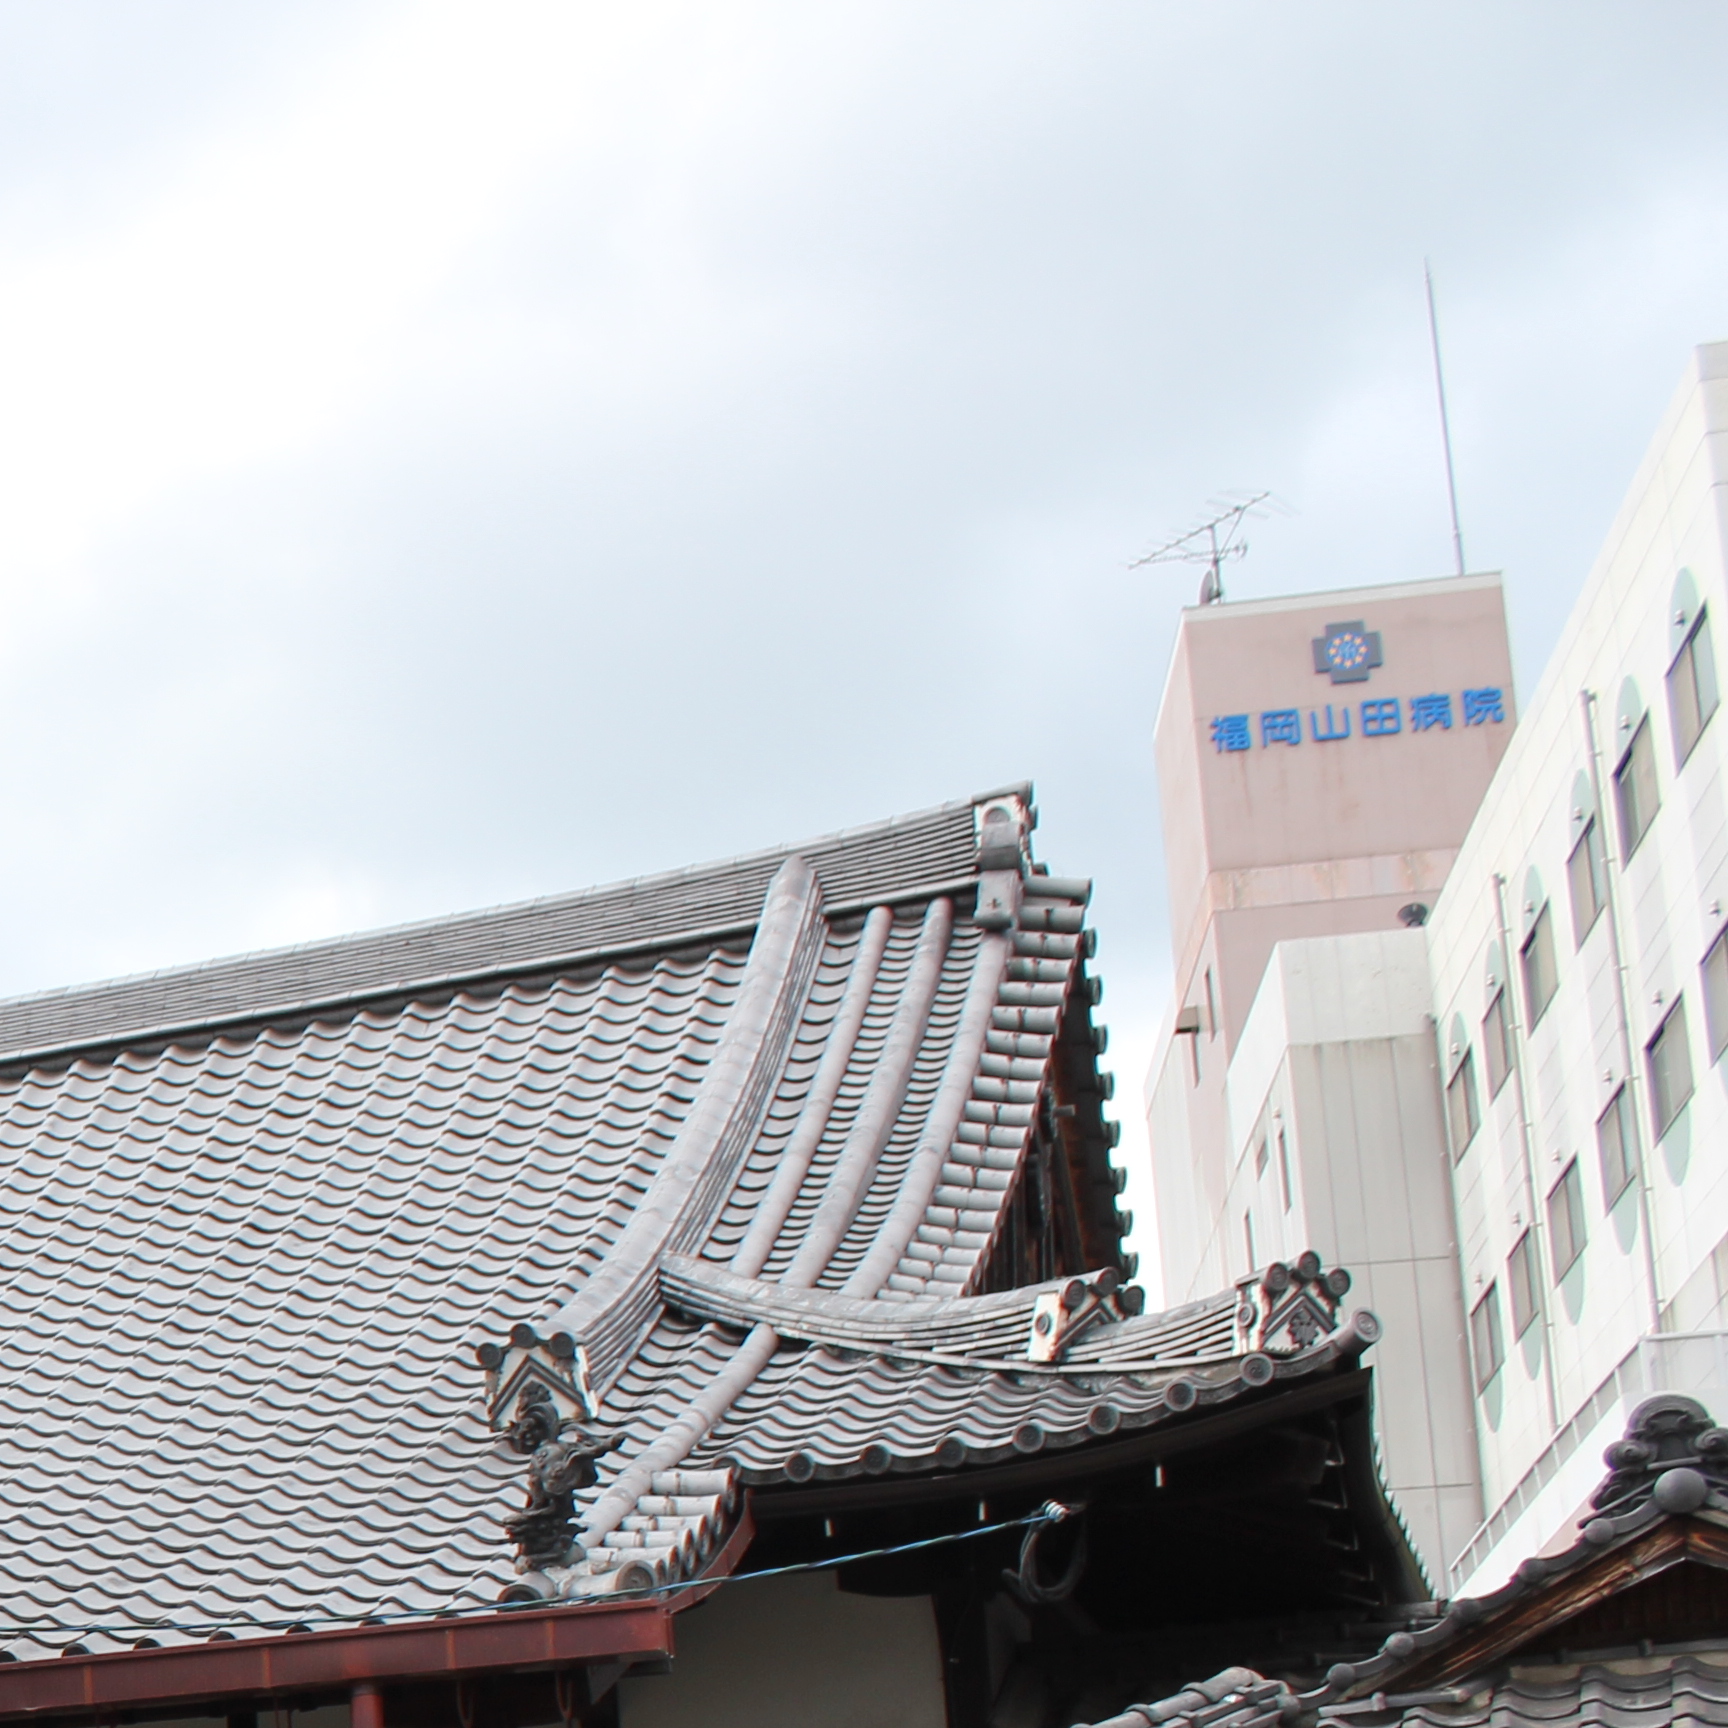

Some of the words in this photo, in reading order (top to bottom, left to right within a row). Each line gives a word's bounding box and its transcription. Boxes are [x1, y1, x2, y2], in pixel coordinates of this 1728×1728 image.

[1211, 688, 1505, 752] 福岡山田病院
